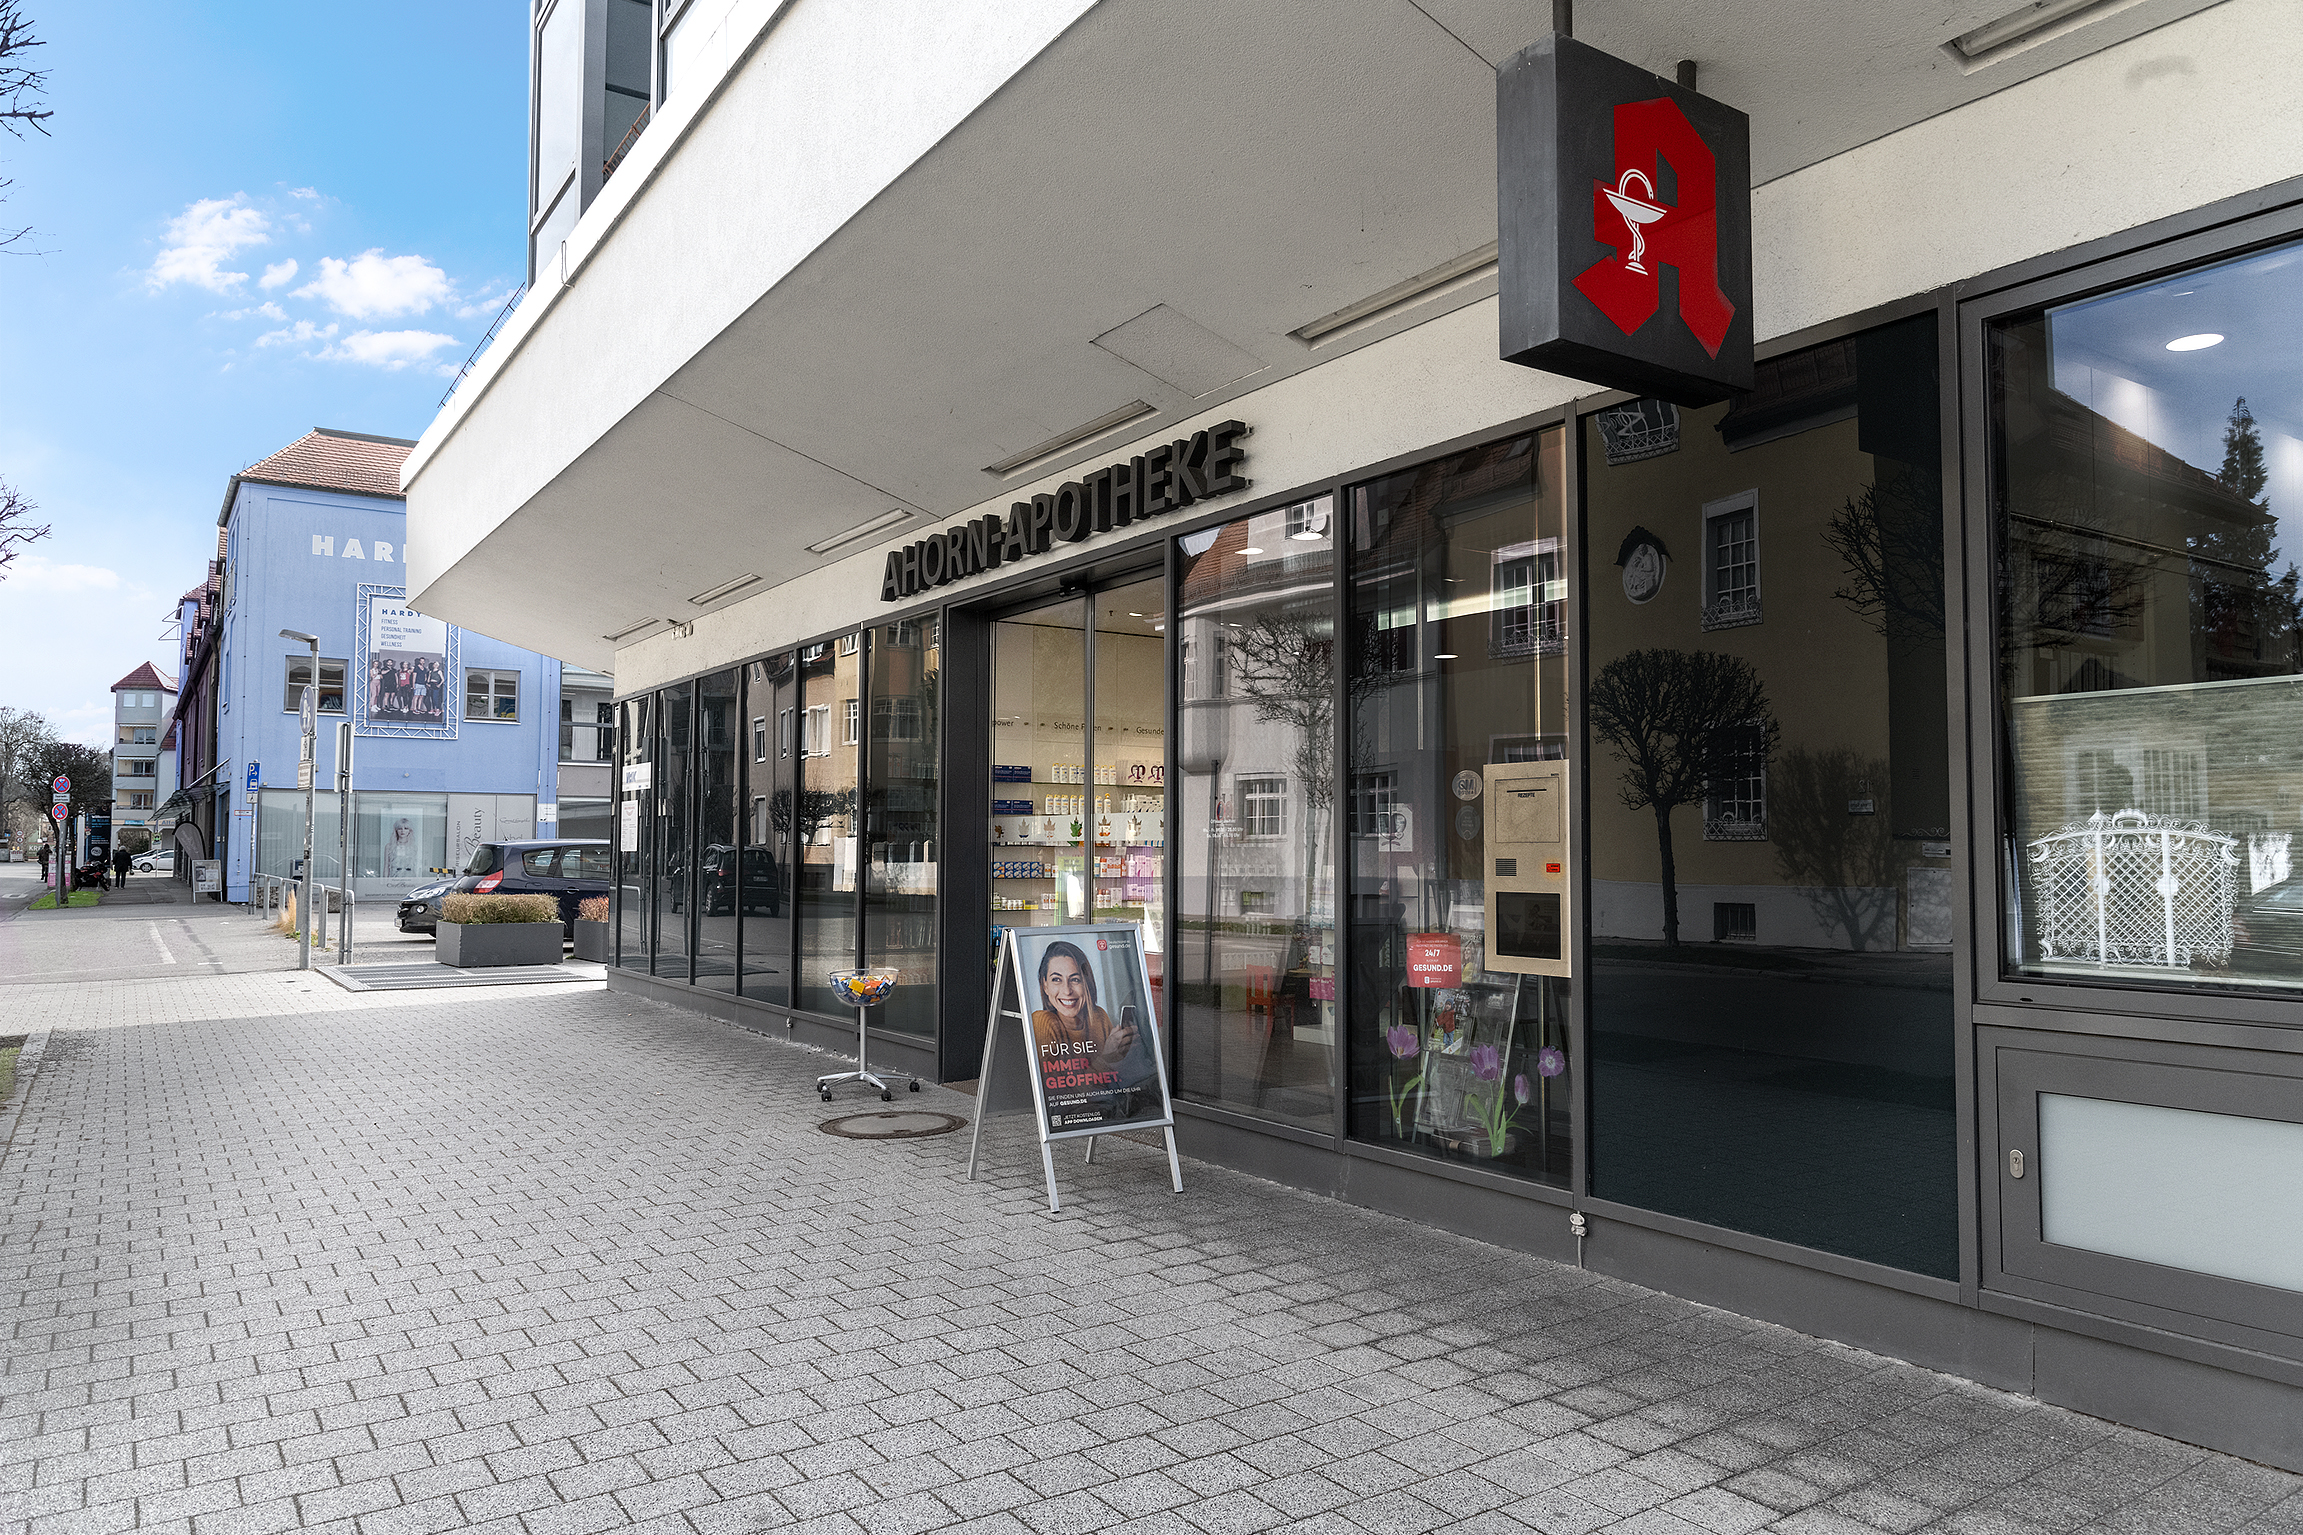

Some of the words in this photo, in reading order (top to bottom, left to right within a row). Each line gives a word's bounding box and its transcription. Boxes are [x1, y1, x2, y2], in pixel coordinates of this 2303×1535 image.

[880, 419, 1248, 601] AHORN-APOTHEKE
[312, 535, 406, 563] HAR
[1053, 721, 1079, 730] Schöne
[1424, 949, 1440, 957] 24/7
[1413, 964, 1453, 972] GESUND.DE
[1041, 1041, 1070, 1057] FÜR
[1073, 1040, 1098, 1054] SIE:
[1043, 1058, 1090, 1073] IMMER
[1046, 1071, 1122, 1089] GEÖFFNET.
